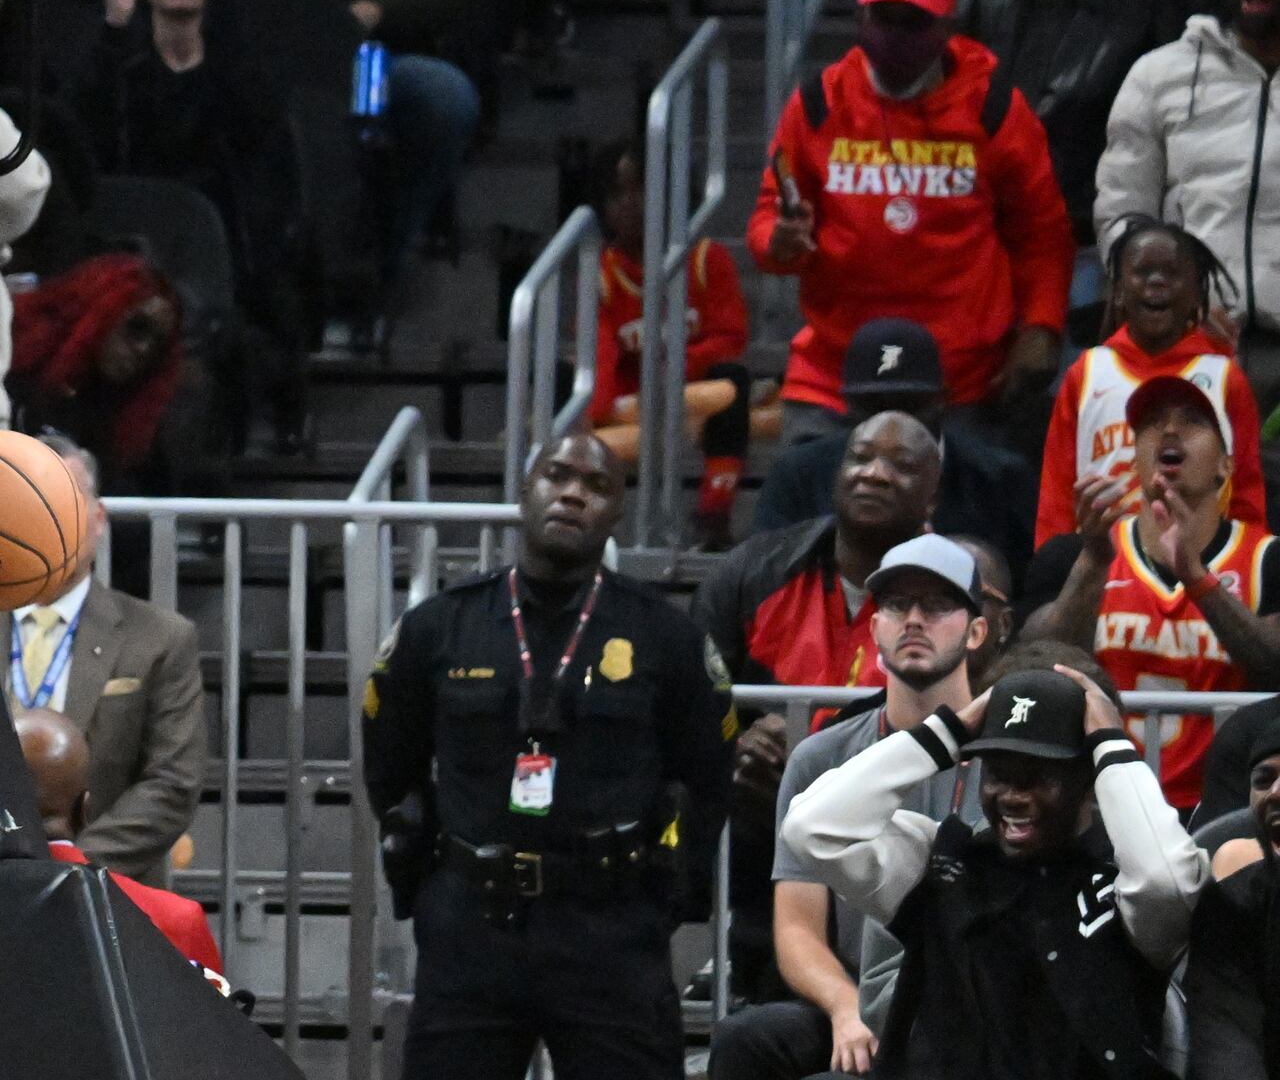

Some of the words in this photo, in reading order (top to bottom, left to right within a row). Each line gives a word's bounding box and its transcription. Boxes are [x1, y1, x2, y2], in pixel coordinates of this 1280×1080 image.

[828, 136, 976, 167] ATLANTA
[824, 163, 977, 197] HAWKS
[1092, 423, 1136, 461] ATL
[1093, 611, 1233, 665] ATLANT
